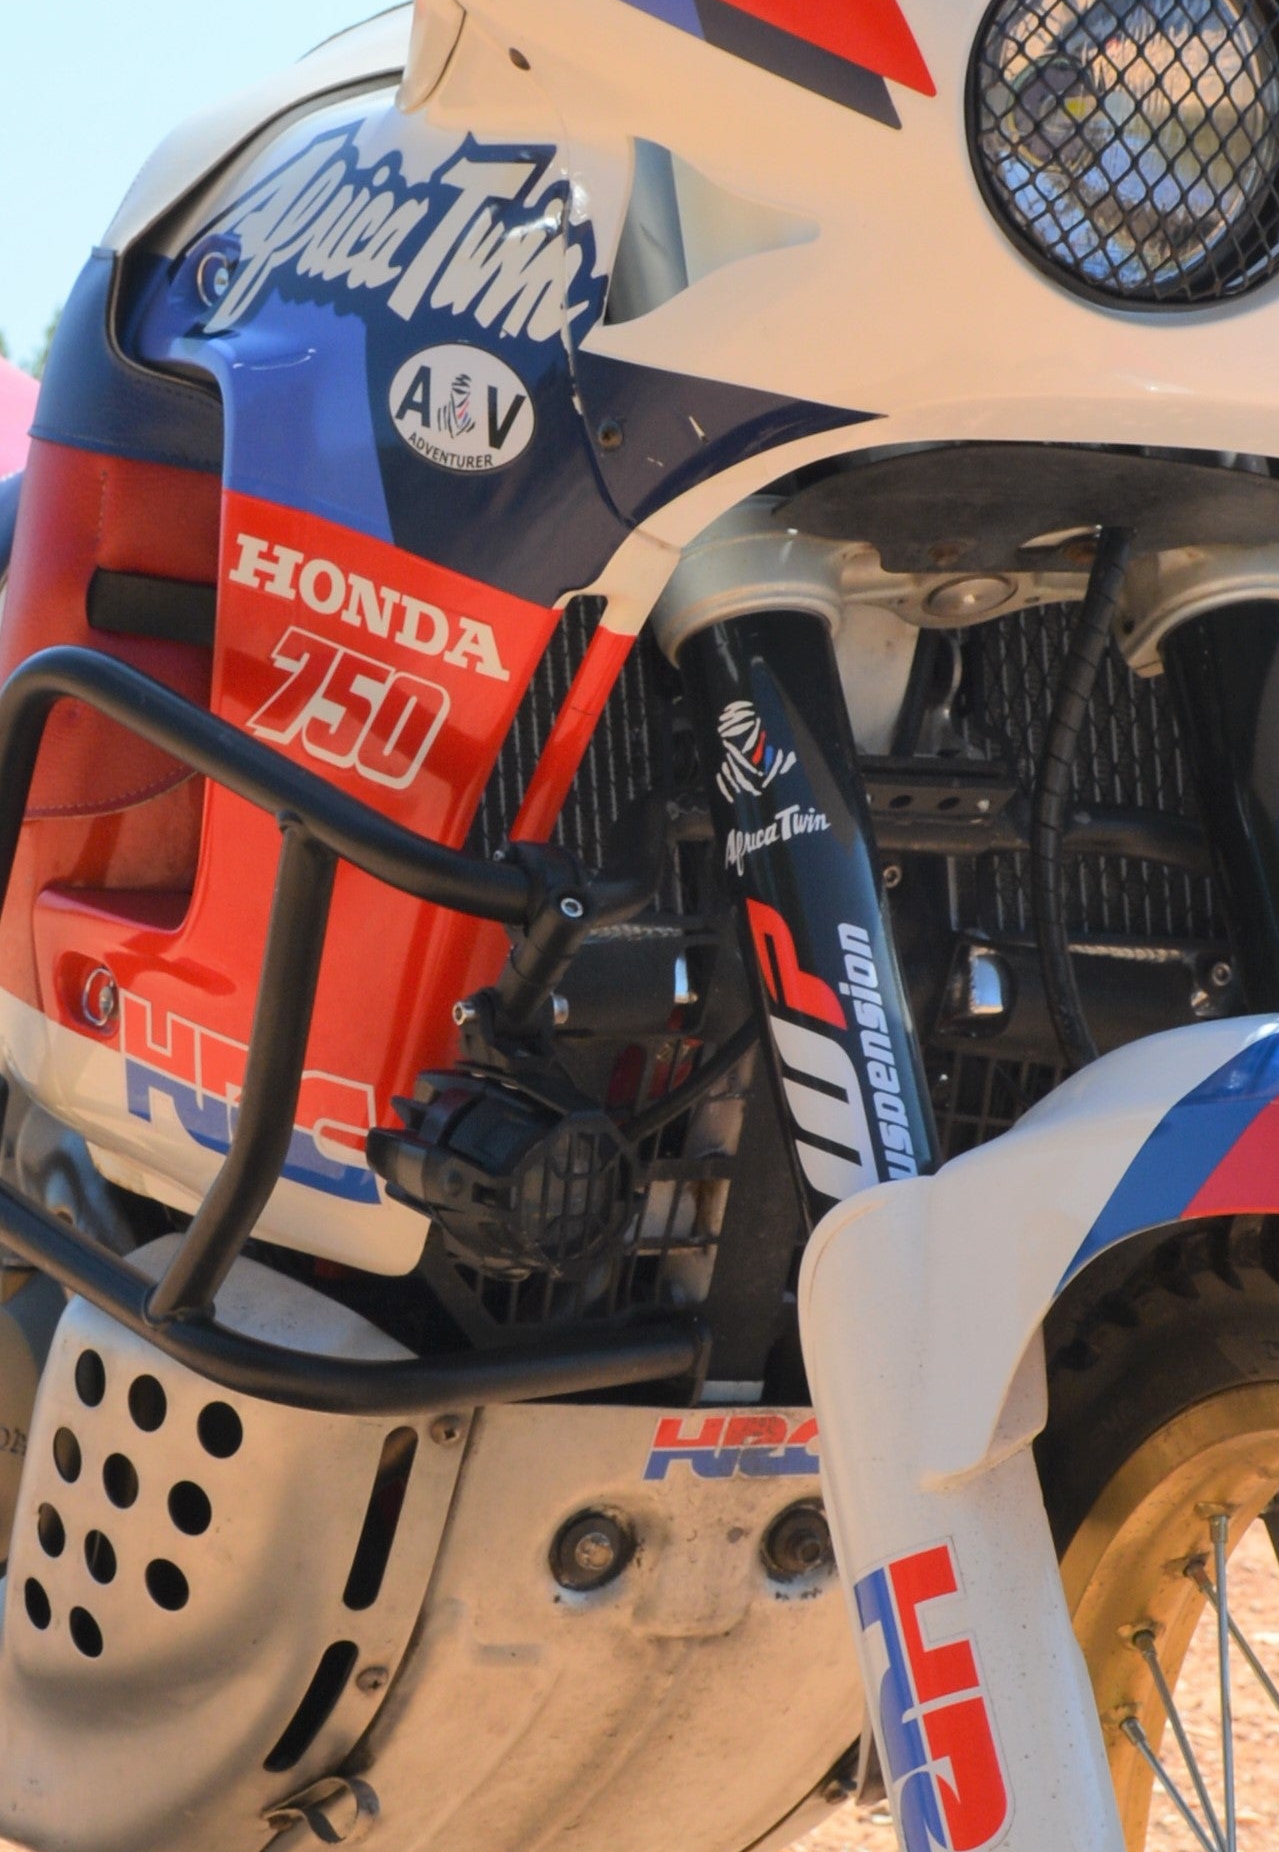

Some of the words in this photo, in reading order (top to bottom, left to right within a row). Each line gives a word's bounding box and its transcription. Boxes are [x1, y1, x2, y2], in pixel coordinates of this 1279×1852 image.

[203, 128, 429, 333] Africa
[387, 157, 590, 343] Twin
[408, 431, 493, 469] ADVENTURER
[229, 534, 510, 681] HONDA
[246, 626, 451, 790] 750
[725, 823, 780, 877] Africa
[775, 804, 831, 841] Twin
[837, 922, 919, 1182] uspension
